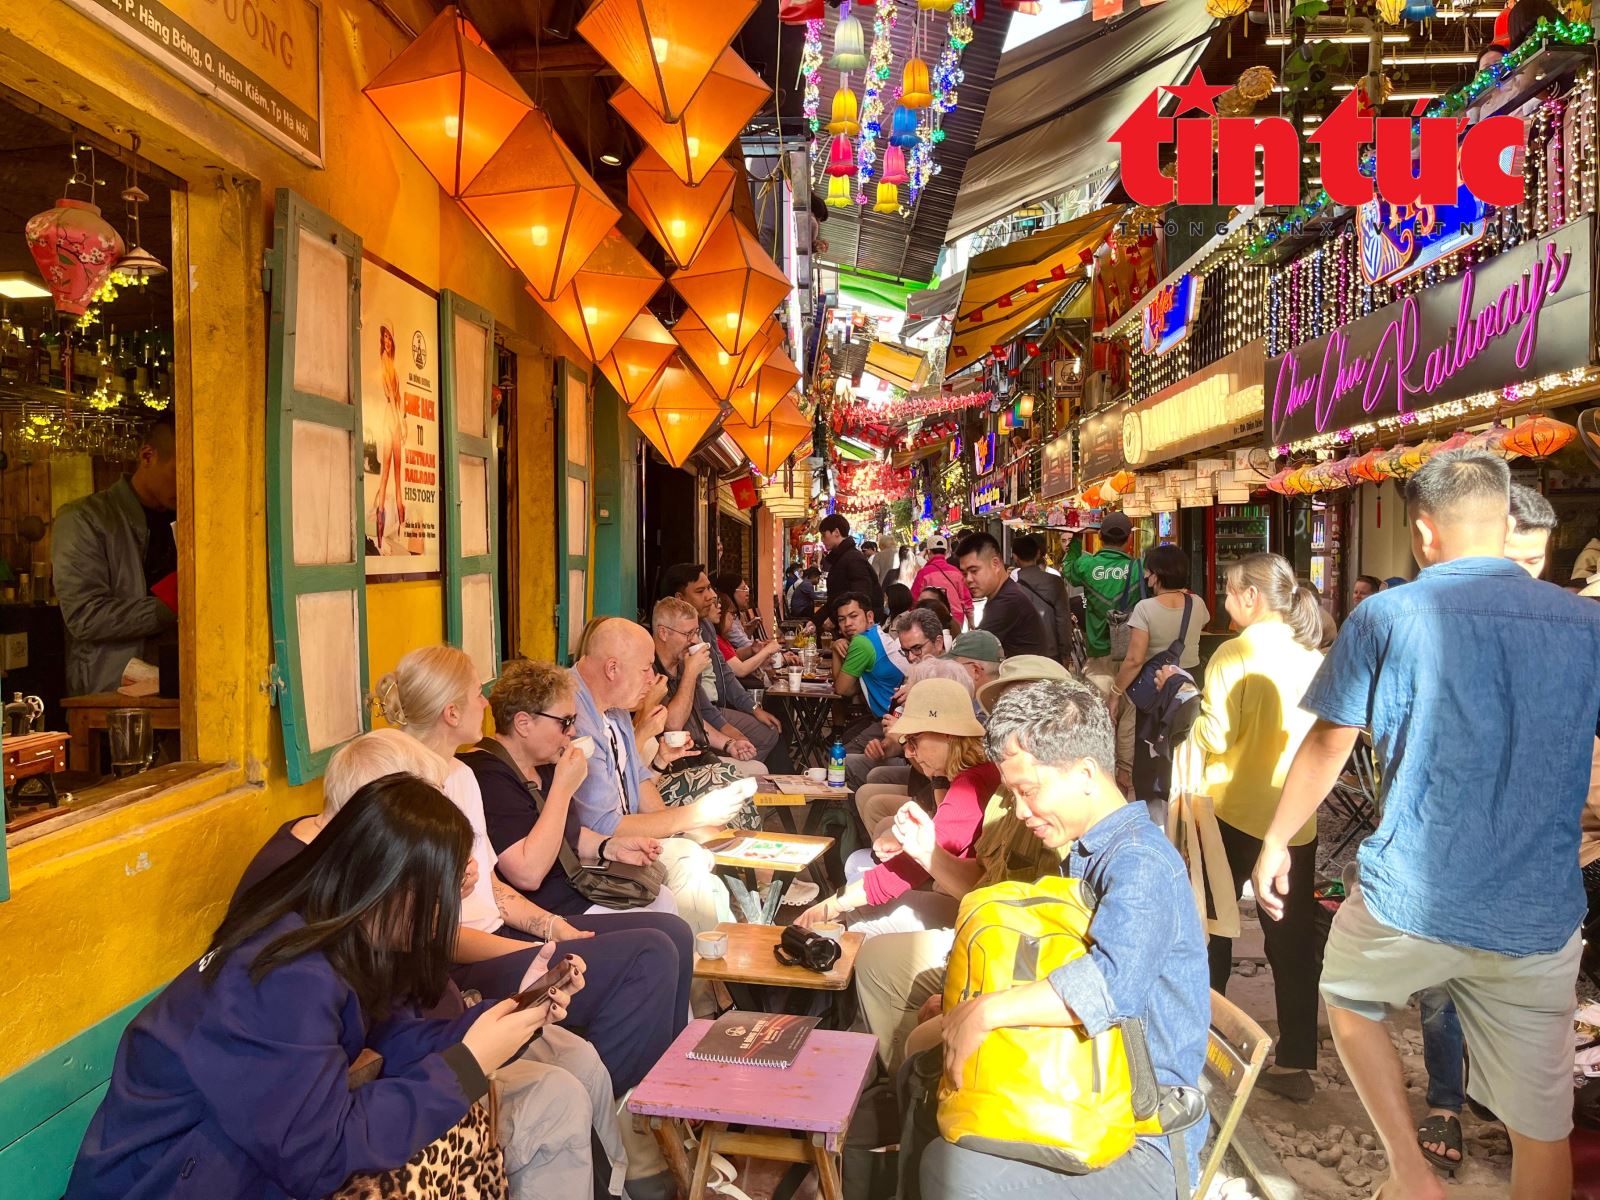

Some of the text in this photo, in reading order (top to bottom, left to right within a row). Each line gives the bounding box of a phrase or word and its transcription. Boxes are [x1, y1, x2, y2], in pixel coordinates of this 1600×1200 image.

[139, 4, 170, 45] Hàng
[172, 27, 203, 68] Bông,
[204, 52, 215, 73] Q.
[218, 62, 243, 92] Hoàn
[271, 100, 282, 123] Tp
[283, 110, 294, 129] Hà
[295, 120, 309, 142] Nội
[1363, 240, 1572, 412] Railways
[416, 424, 424, 446] TO
[404, 487, 436, 503] HISTORY
